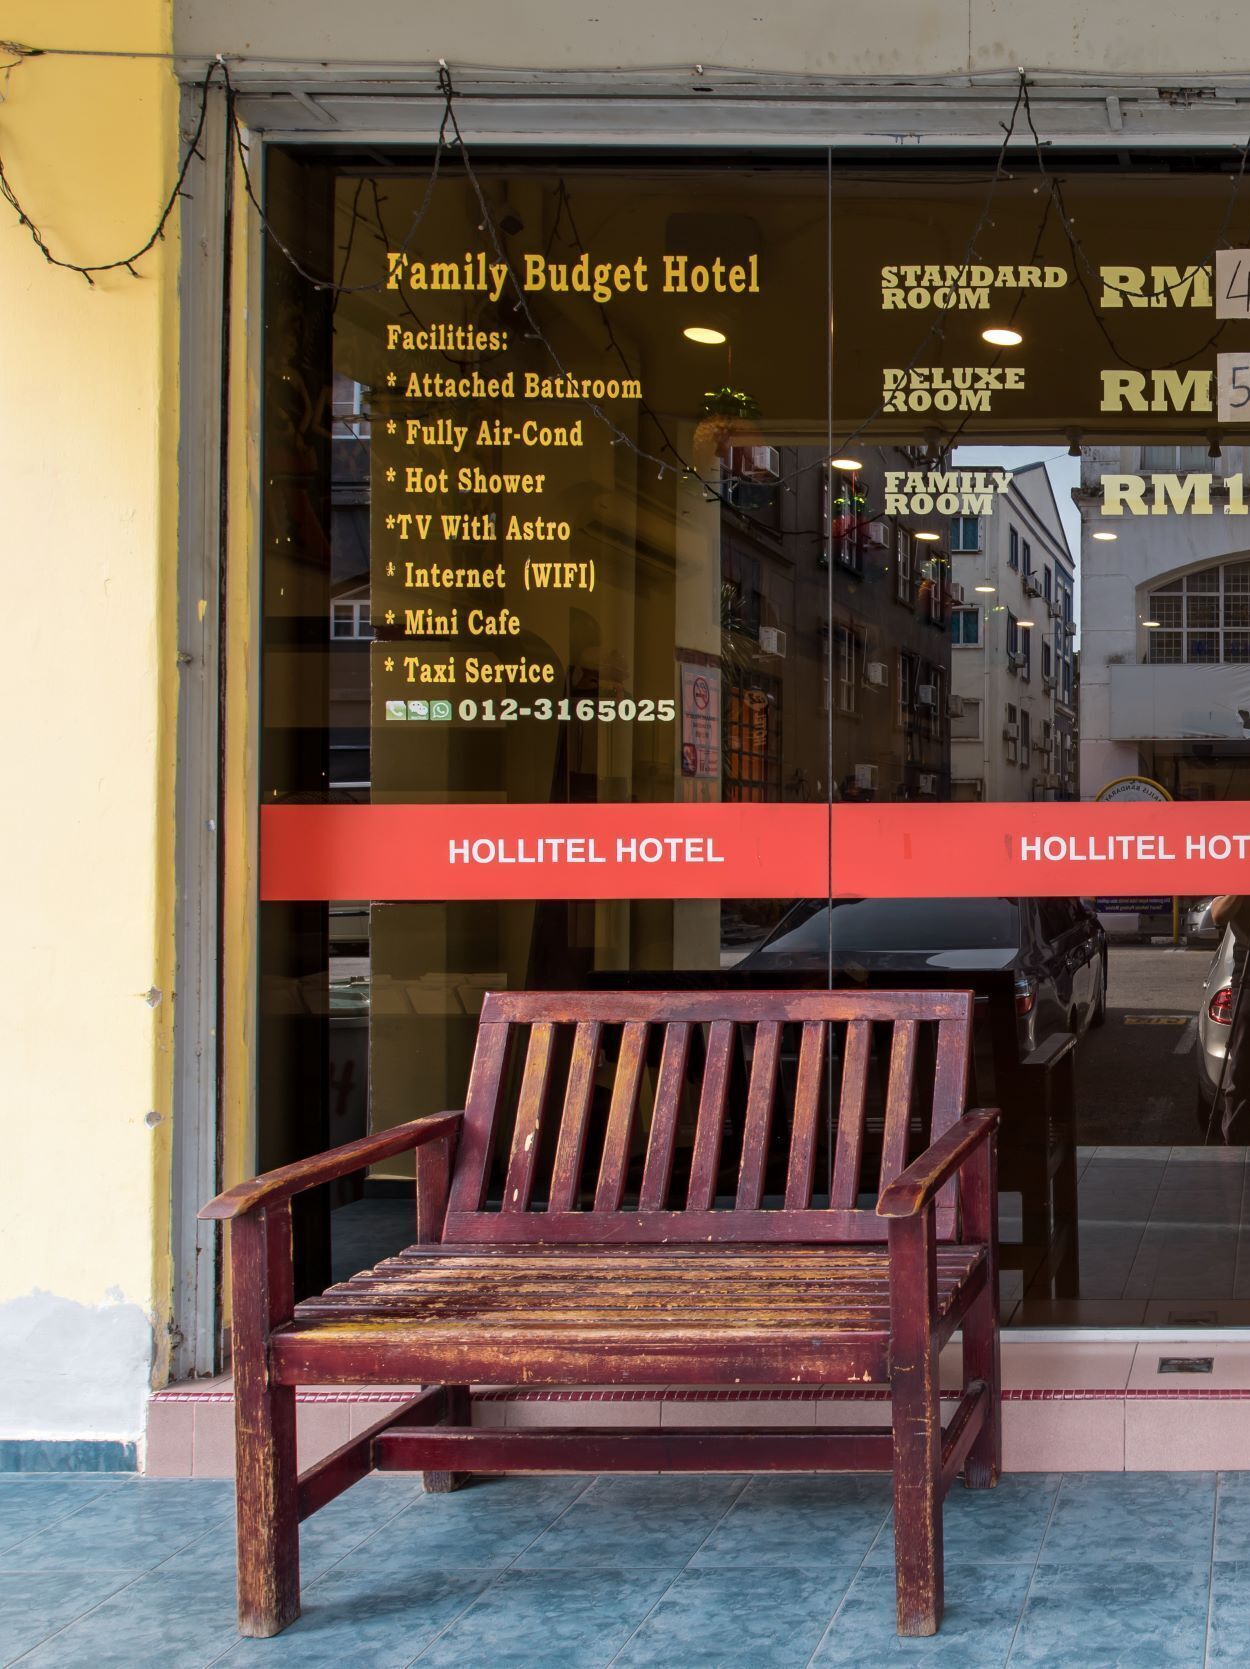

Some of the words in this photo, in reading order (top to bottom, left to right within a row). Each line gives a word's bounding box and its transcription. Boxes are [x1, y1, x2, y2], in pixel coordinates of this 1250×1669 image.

[387, 252, 508, 302] Family
[524, 253, 648, 303] Budget
[663, 254, 760, 293] Hotel
[881, 265, 1068, 288] STANDARD
[1100, 266, 1213, 308] RM
[881, 288, 990, 310] ROOM
[387, 324, 508, 351] Facilities:
[405, 372, 515, 398] Attached
[525, 372, 643, 399] Bathroom
[883, 368, 1025, 391] DELUXE
[1101, 370, 1213, 412] RM
[882, 390, 992, 412] ROOM
[405, 419, 469, 453] Fully
[476, 420, 584, 447] Air-Cond
[405, 467, 449, 494] Hot
[458, 467, 546, 494] Shower
[884, 472, 1015, 494] FAMILY
[884, 494, 993, 516] ROOM
[441, 514, 497, 541] With
[506, 515, 571, 541] Astro
[405, 561, 506, 589] Internet
[523, 557, 596, 593] (WIFI)
[404, 608, 459, 635] Mini
[468, 608, 521, 635] Cafe
[403, 656, 456, 683] Taxi
[465, 656, 555, 683] Service
[458, 699, 676, 722] 012-3165025
[449, 838, 607, 863] HOLLITEL
[616, 837, 725, 863] HOTEL
[1021, 835, 1176, 861] HOLLITEL
